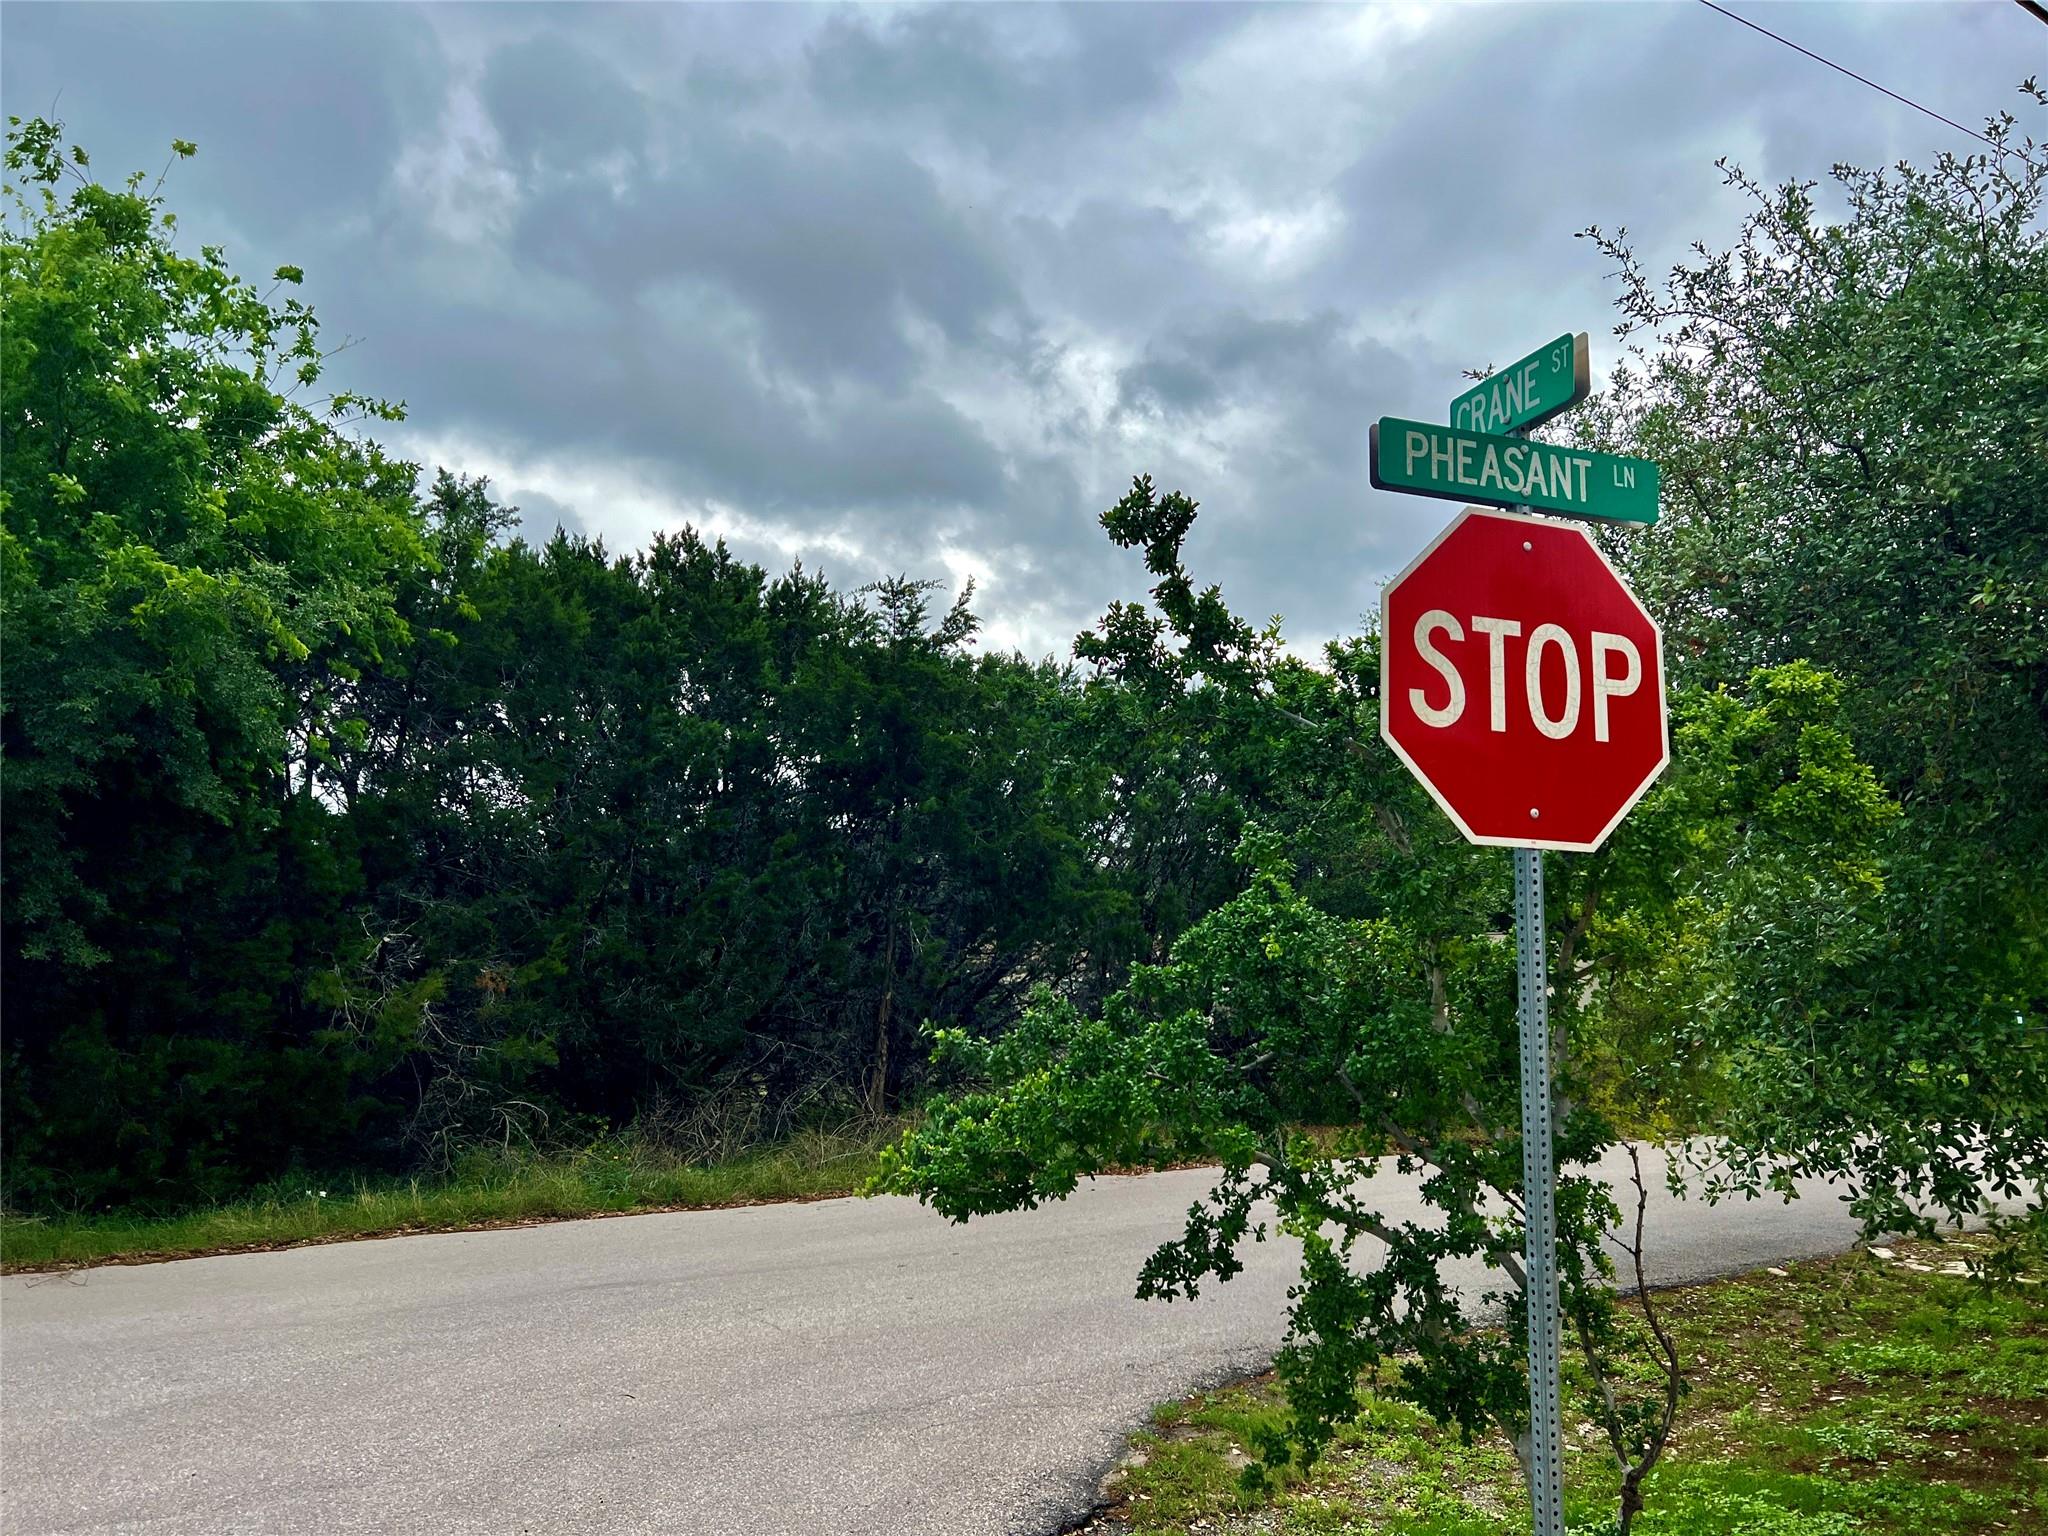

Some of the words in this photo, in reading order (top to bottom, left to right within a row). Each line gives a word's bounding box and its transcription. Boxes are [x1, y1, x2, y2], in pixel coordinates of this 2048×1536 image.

[1456, 360, 1541, 434] CRANE
[1551, 343, 1569, 374] ST
[1405, 430, 1592, 503] PHEASANT
[1613, 463, 1635, 489] LN
[1408, 609, 1642, 743] STOP
